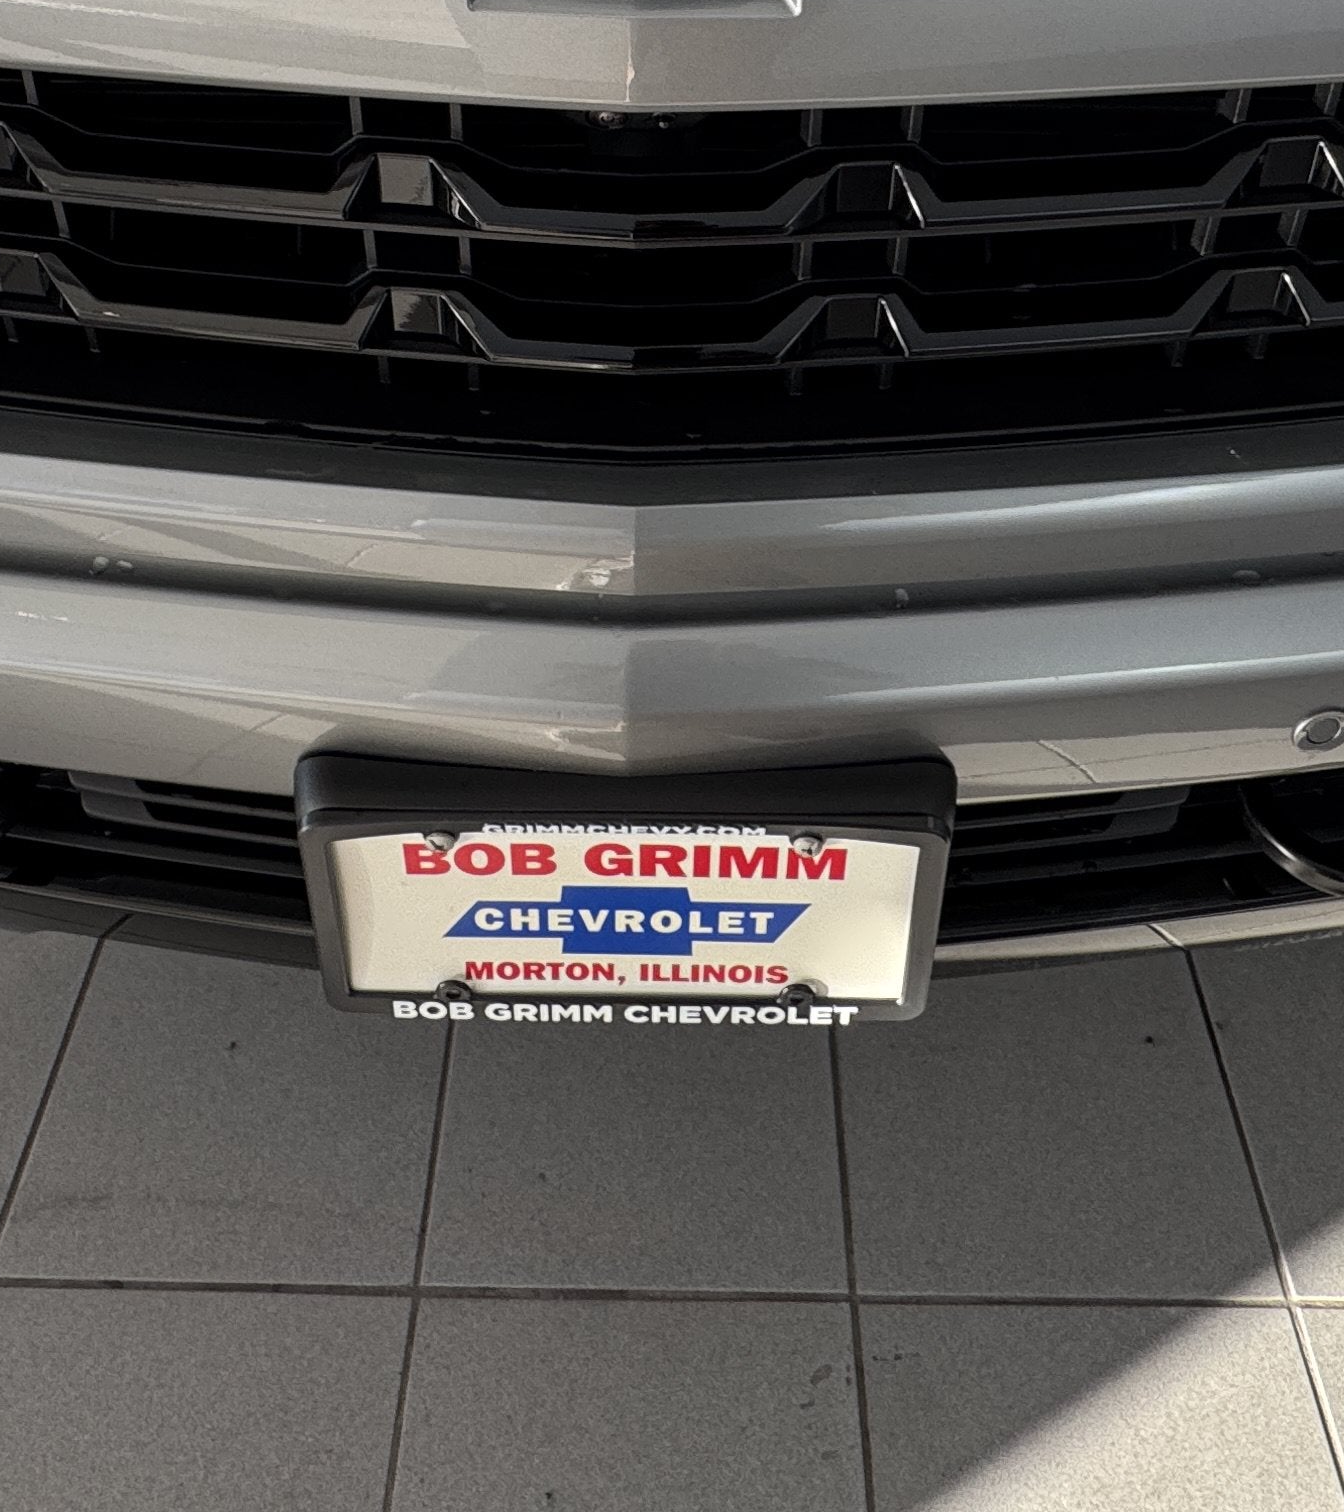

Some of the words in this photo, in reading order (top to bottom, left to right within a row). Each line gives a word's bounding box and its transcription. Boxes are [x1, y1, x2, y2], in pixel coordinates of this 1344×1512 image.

[482, 823, 767, 837] GRIMMCHEVY.COM
[402, 843, 558, 876] BOB
[584, 843, 848, 880] GRIMM
[474, 908, 774, 935] CHEVROLET
[465, 961, 626, 985] MORTON,
[639, 963, 789, 984] ILLINOIS
[392, 1000, 475, 1020] BOB
[484, 1002, 614, 1023] GRIMM
[623, 1004, 859, 1026] CHEVROLET
